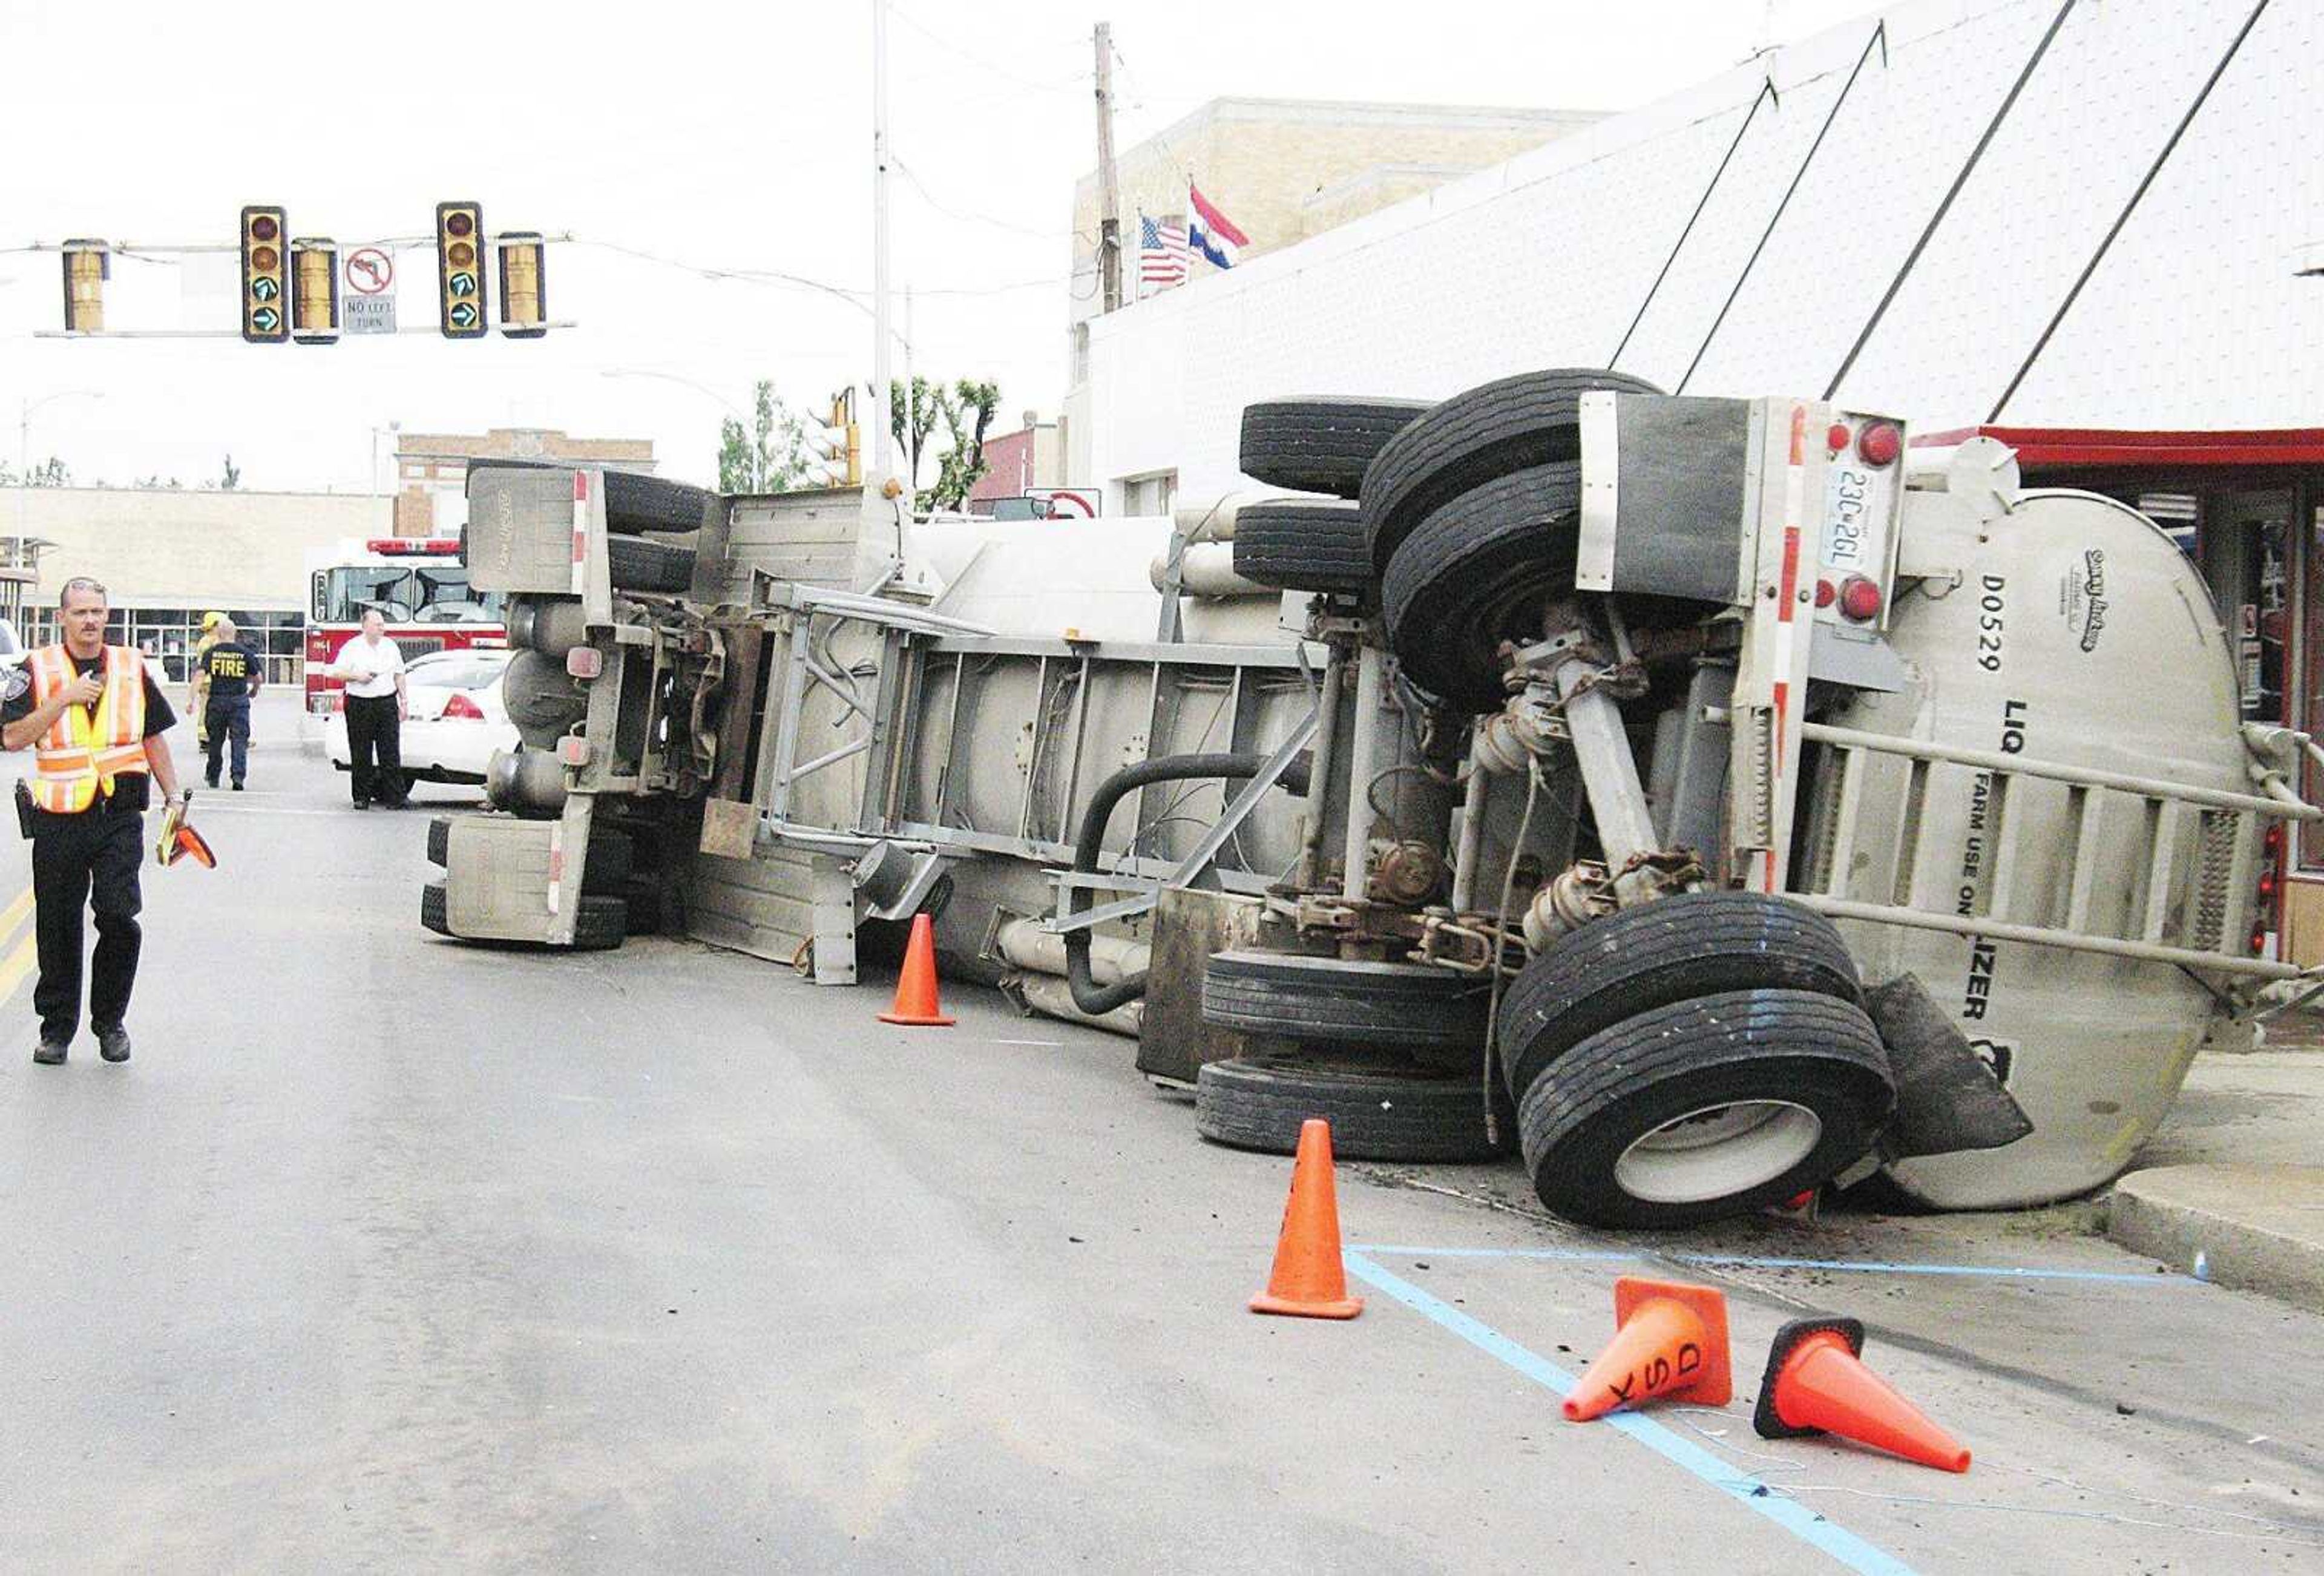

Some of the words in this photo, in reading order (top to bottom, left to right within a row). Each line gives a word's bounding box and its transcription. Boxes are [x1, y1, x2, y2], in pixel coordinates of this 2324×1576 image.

[349, 301, 364, 314] NO
[358, 317, 382, 326] TURN
[211, 658, 246, 677] FIRE
[2000, 700, 2028, 755] LIQ
[1969, 773, 1990, 830] FARM
[1963, 837, 1981, 878] USE
[1957, 885, 1974, 916] ON
